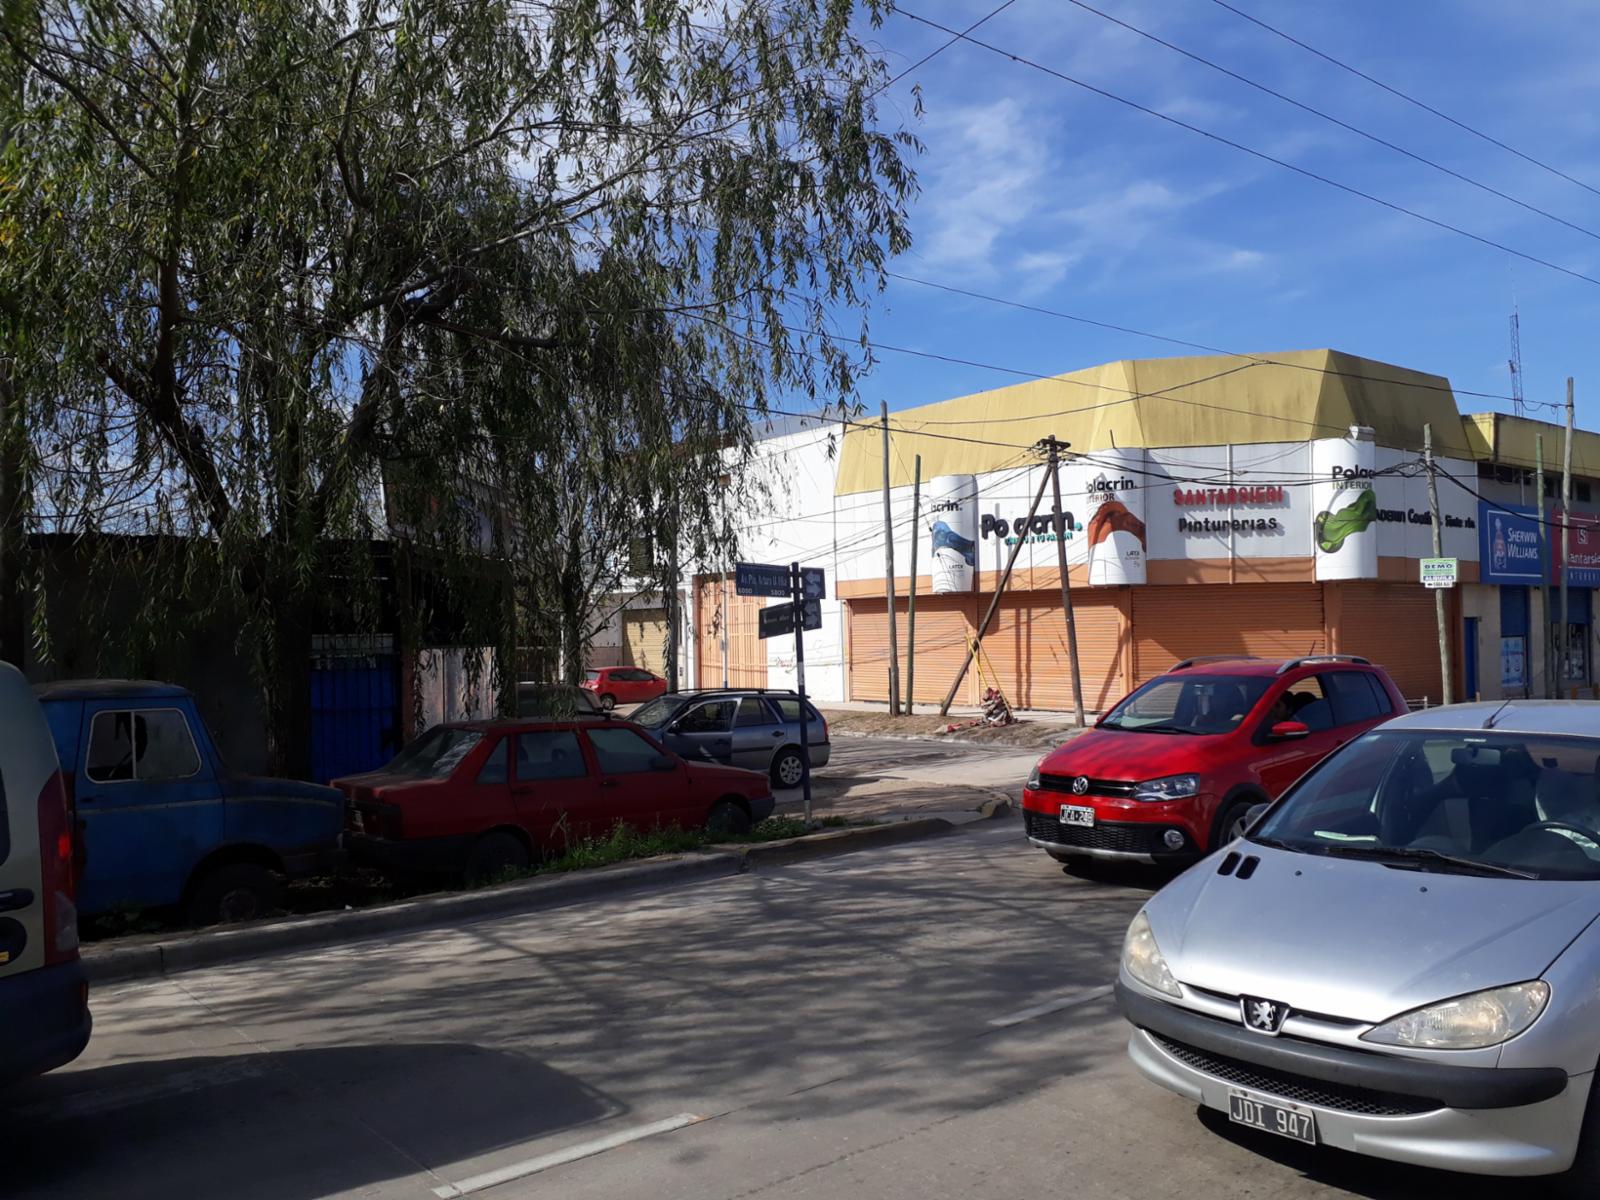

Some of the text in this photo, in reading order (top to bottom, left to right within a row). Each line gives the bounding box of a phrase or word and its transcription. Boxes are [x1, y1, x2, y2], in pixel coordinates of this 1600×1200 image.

[1173, 486, 1284, 506] SANTARSIERI
[1507, 527, 1537, 544] SHERWIN
[1507, 543, 1538, 559] WILLIAMS
[1233, 1099, 1310, 1139] JDI 947
